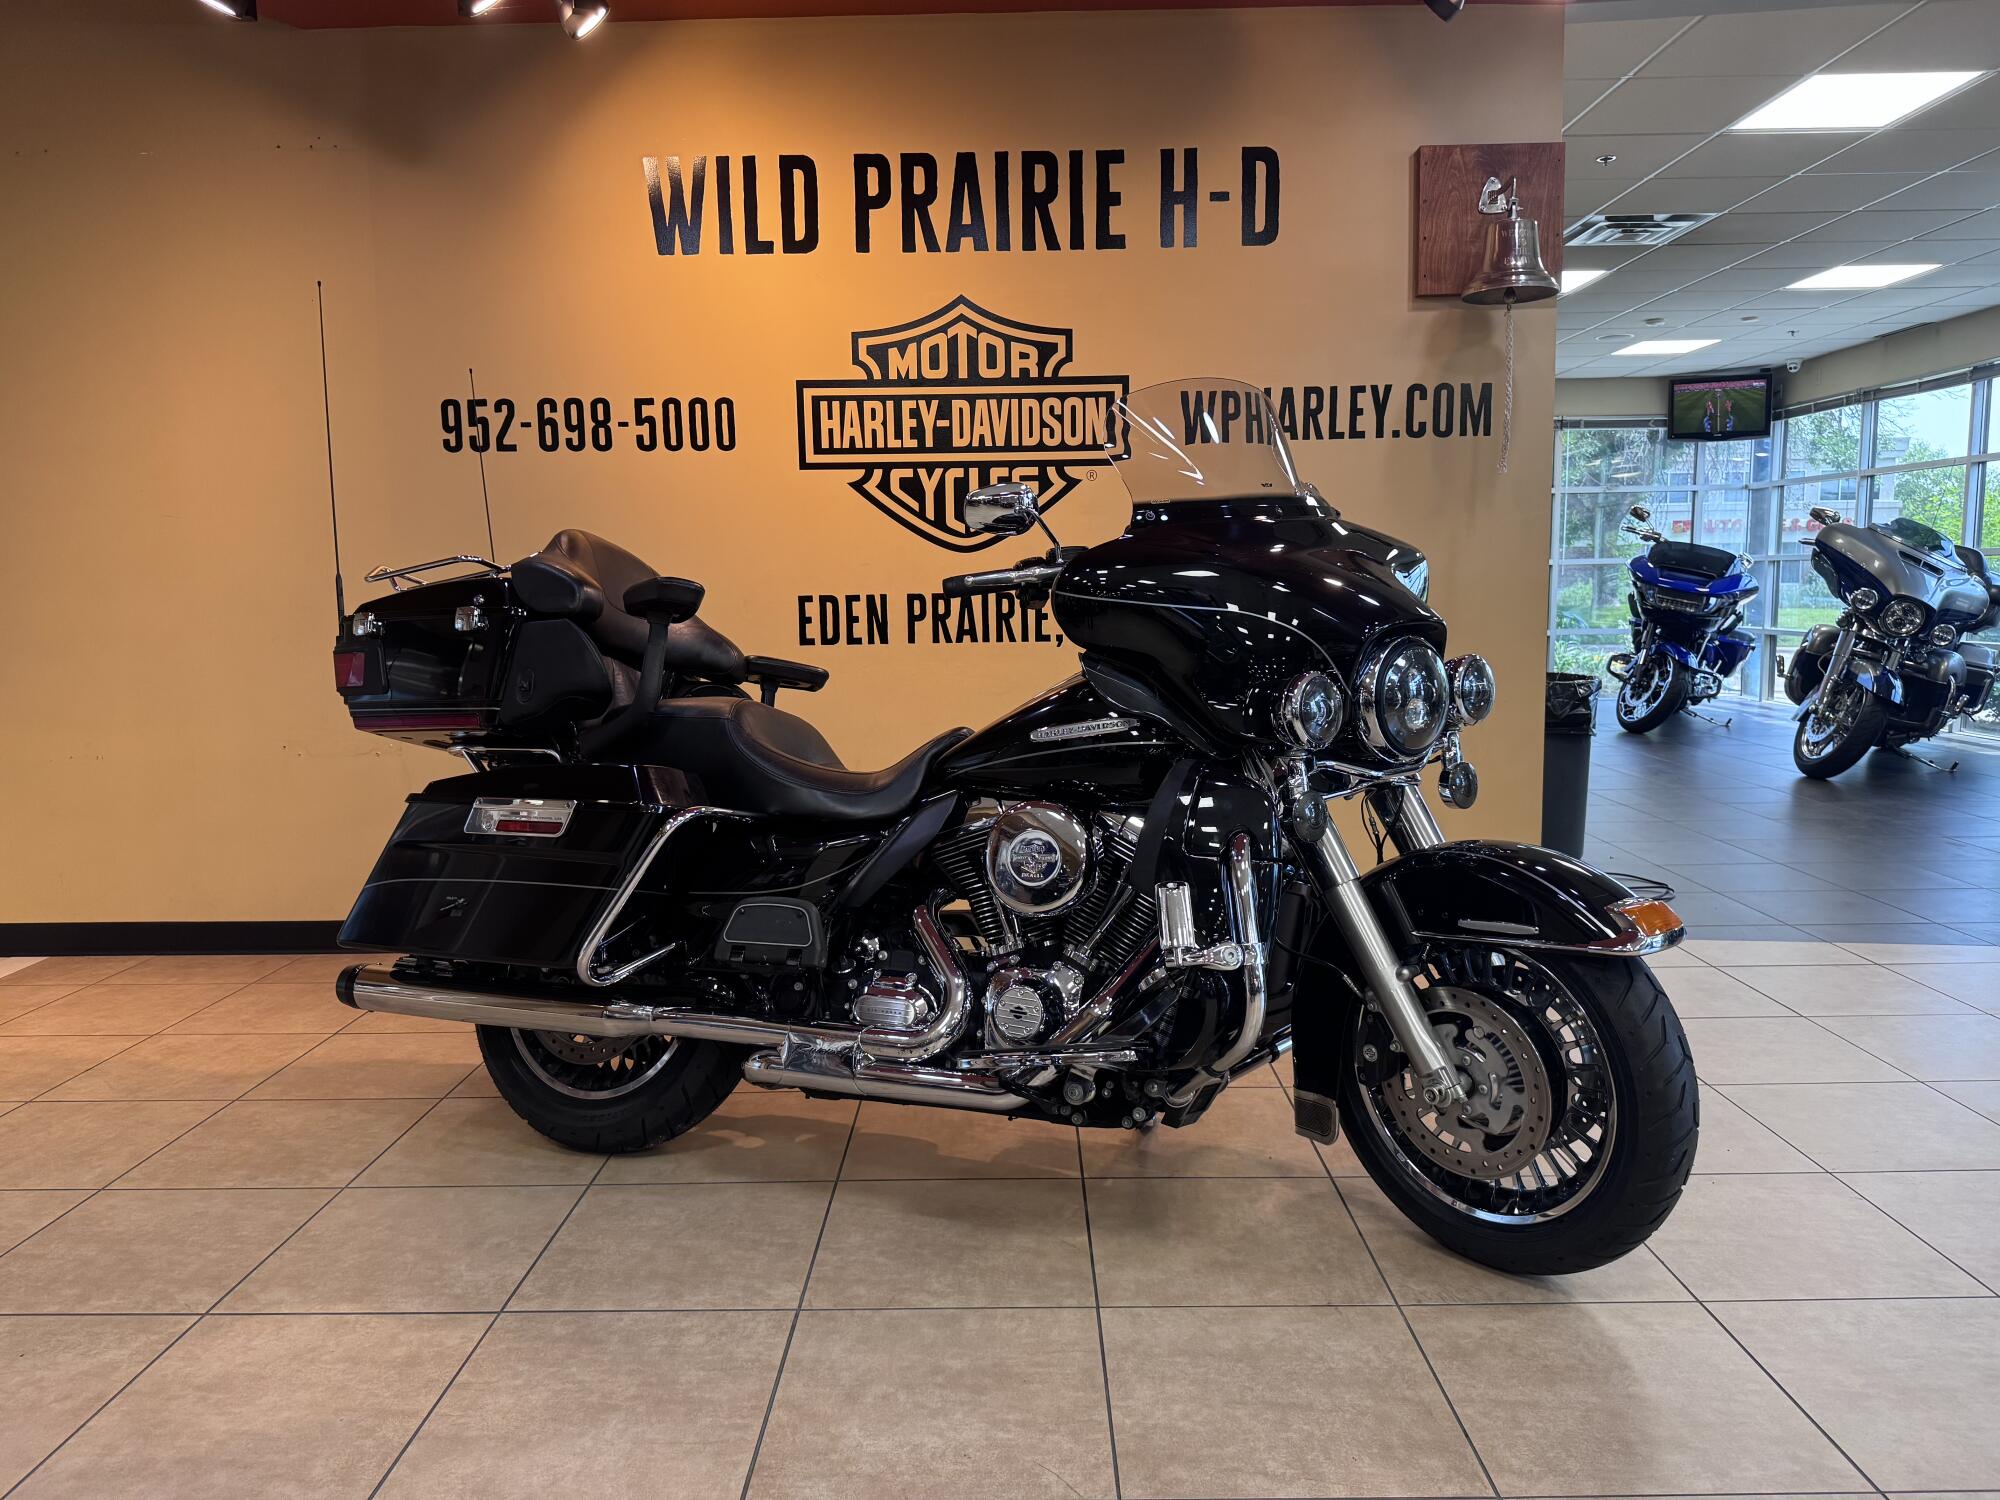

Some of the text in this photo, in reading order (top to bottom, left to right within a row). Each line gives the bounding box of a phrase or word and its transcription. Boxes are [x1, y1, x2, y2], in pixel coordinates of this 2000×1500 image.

[642, 146, 1280, 255] WILD PRAIRIE H-D
[888, 320, 1038, 380] MOTOR
[440, 397, 736, 453] 952-698-5000
[819, 396, 1107, 449] HARLEY-DAVIDSON
[1180, 382, 1493, 446] WPHARLEY.COM
[797, 593, 889, 646] EDEN
